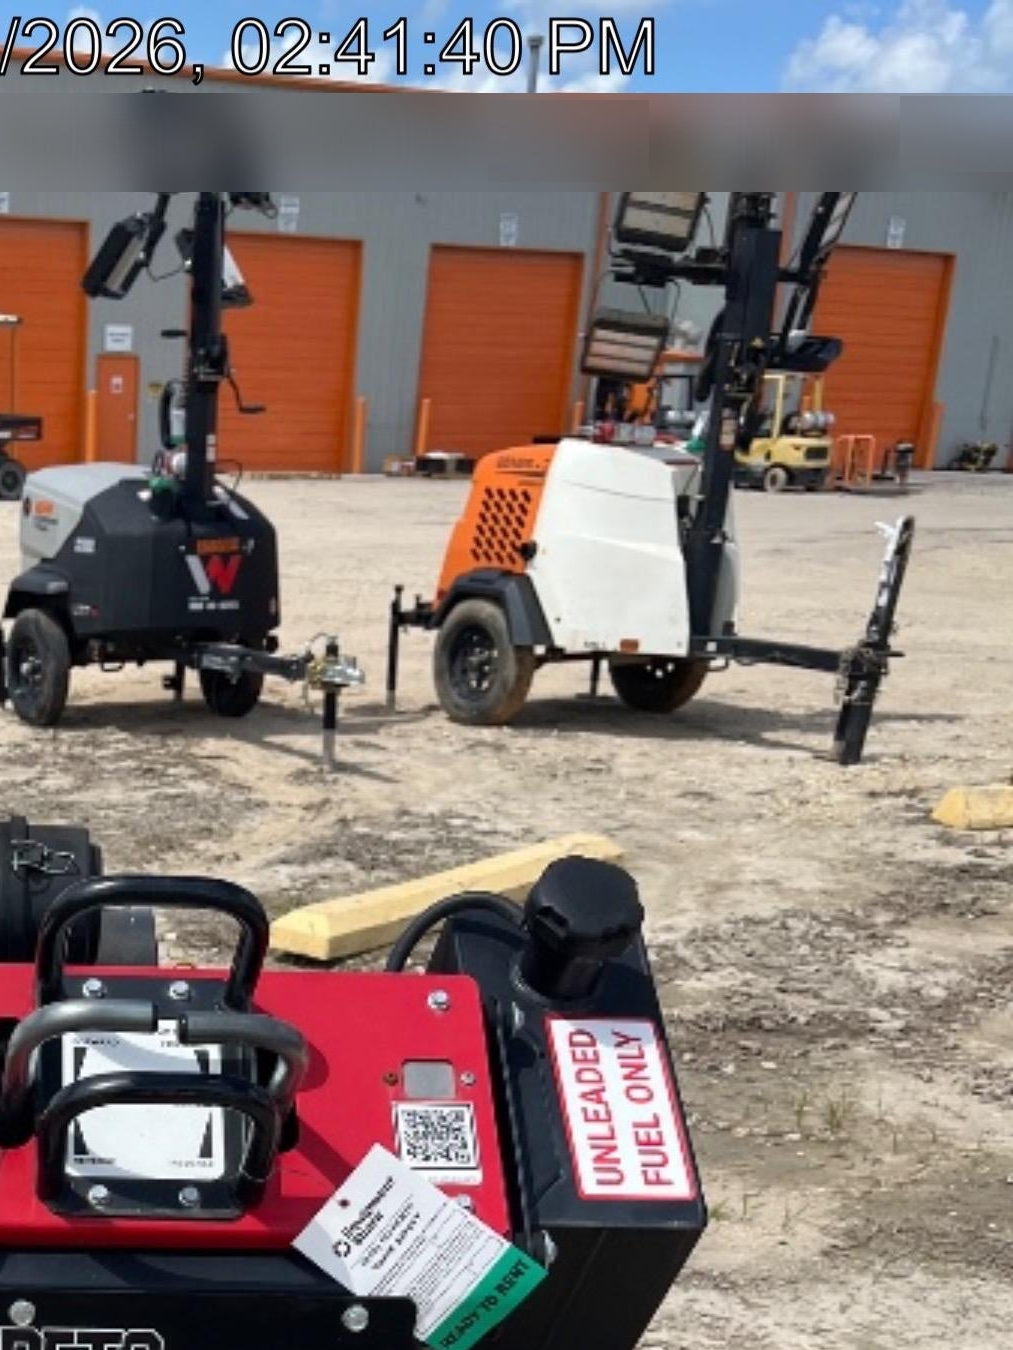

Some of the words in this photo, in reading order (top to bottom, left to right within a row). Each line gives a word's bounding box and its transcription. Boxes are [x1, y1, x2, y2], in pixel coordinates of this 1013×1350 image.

[612, 1028, 655, 1105] ONLY
[569, 1028, 625, 1186] UNLEADED
[632, 1112, 674, 1186] FUEL
